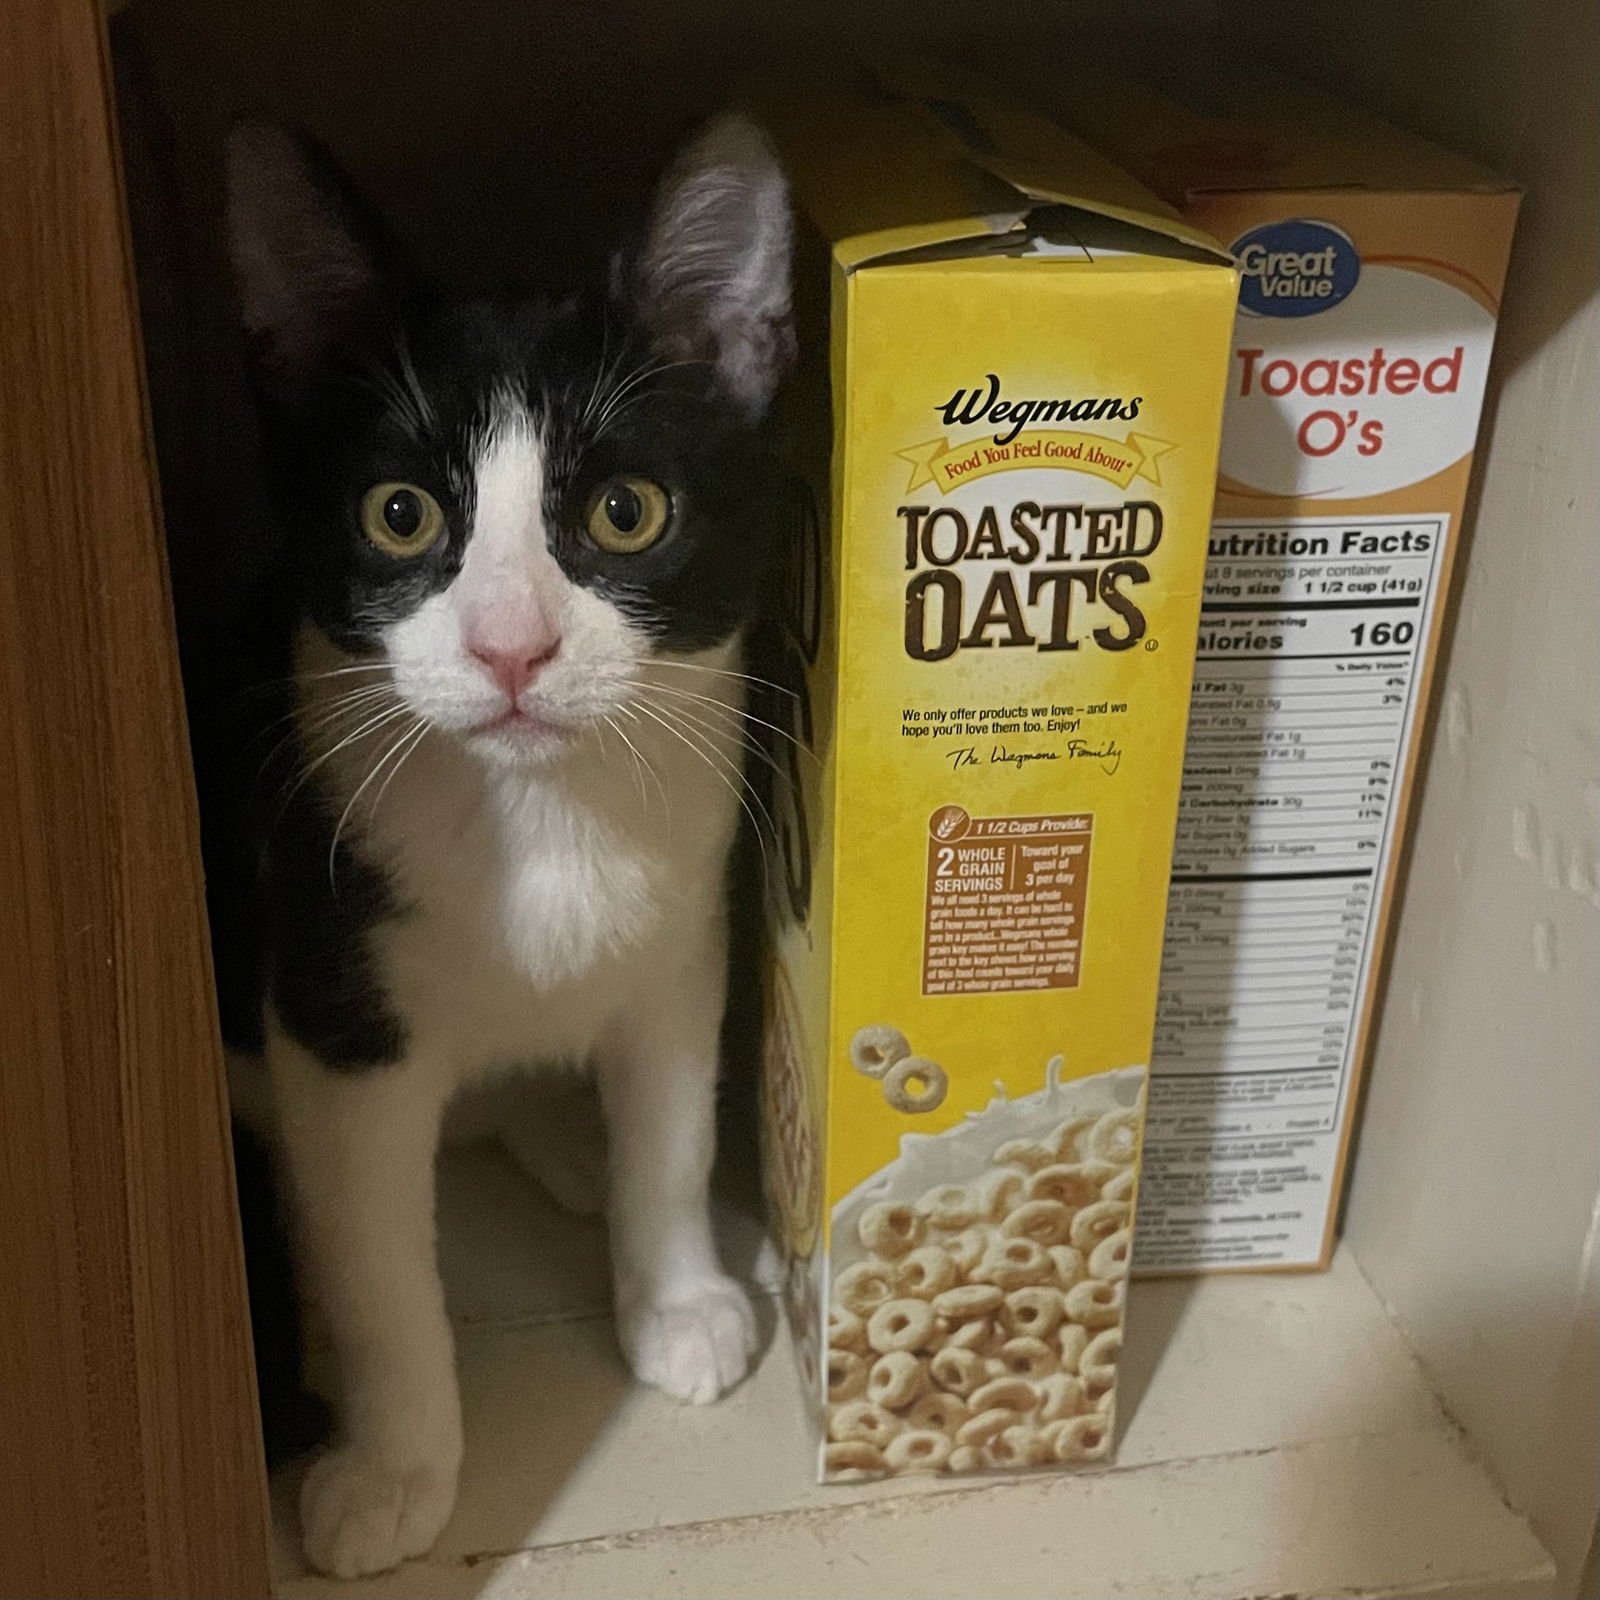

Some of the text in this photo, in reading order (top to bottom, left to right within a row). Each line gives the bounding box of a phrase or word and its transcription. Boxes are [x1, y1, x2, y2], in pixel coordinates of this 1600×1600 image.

[1240, 244, 1337, 277] Great
[1260, 273, 1333, 298] Value
[1237, 346, 1464, 397] Toasted
[934, 373, 1144, 445] Wegmans
[1298, 409, 1384, 458] O's
[944, 454, 983, 481] Food
[983, 447, 1011, 465] You
[1013, 443, 1041, 460] Feel
[1044, 442, 1084, 459] Good
[897, 500, 1164, 569] TOASTED
[1207, 530, 1432, 557] utrition Facts
[1223, 566, 1231, 579] 8
[1235, 566, 1295, 581] servings
[1298, 567, 1322, 581] per
[1326, 564, 1392, 577] container
[1204, 577, 1423, 597] ving size 1 1/2 cup (41g)
[904, 560, 1151, 662] OATS
[1258, 616, 1308, 629] serving
[1197, 620, 1415, 651] alories 160
[902, 709, 920, 721] We
[923, 708, 947, 723] only
[950, 707, 976, 721] offer
[979, 705, 1028, 722] products
[1031, 707, 1048, 718] we
[1051, 704, 1074, 717] love
[1086, 702, 1108, 715] and
[1110, 703, 1128, 713] we
[902, 718, 1081, 738] hope you'll love them too. Enjoy!
[946, 746, 982, 770] The
[976, 822, 985, 835] 1
[988, 821, 1008, 835] 1/2
[1008, 820, 1039, 835] Cups
[936, 847, 1006, 877] 2 WHOLE
[1021, 844, 1084, 857] Toward your
[959, 862, 1005, 877] GRAIN
[1058, 857, 1069, 869] of
[934, 876, 1004, 893] SERVINGS
[1025, 872, 1076, 887] 3 per day
